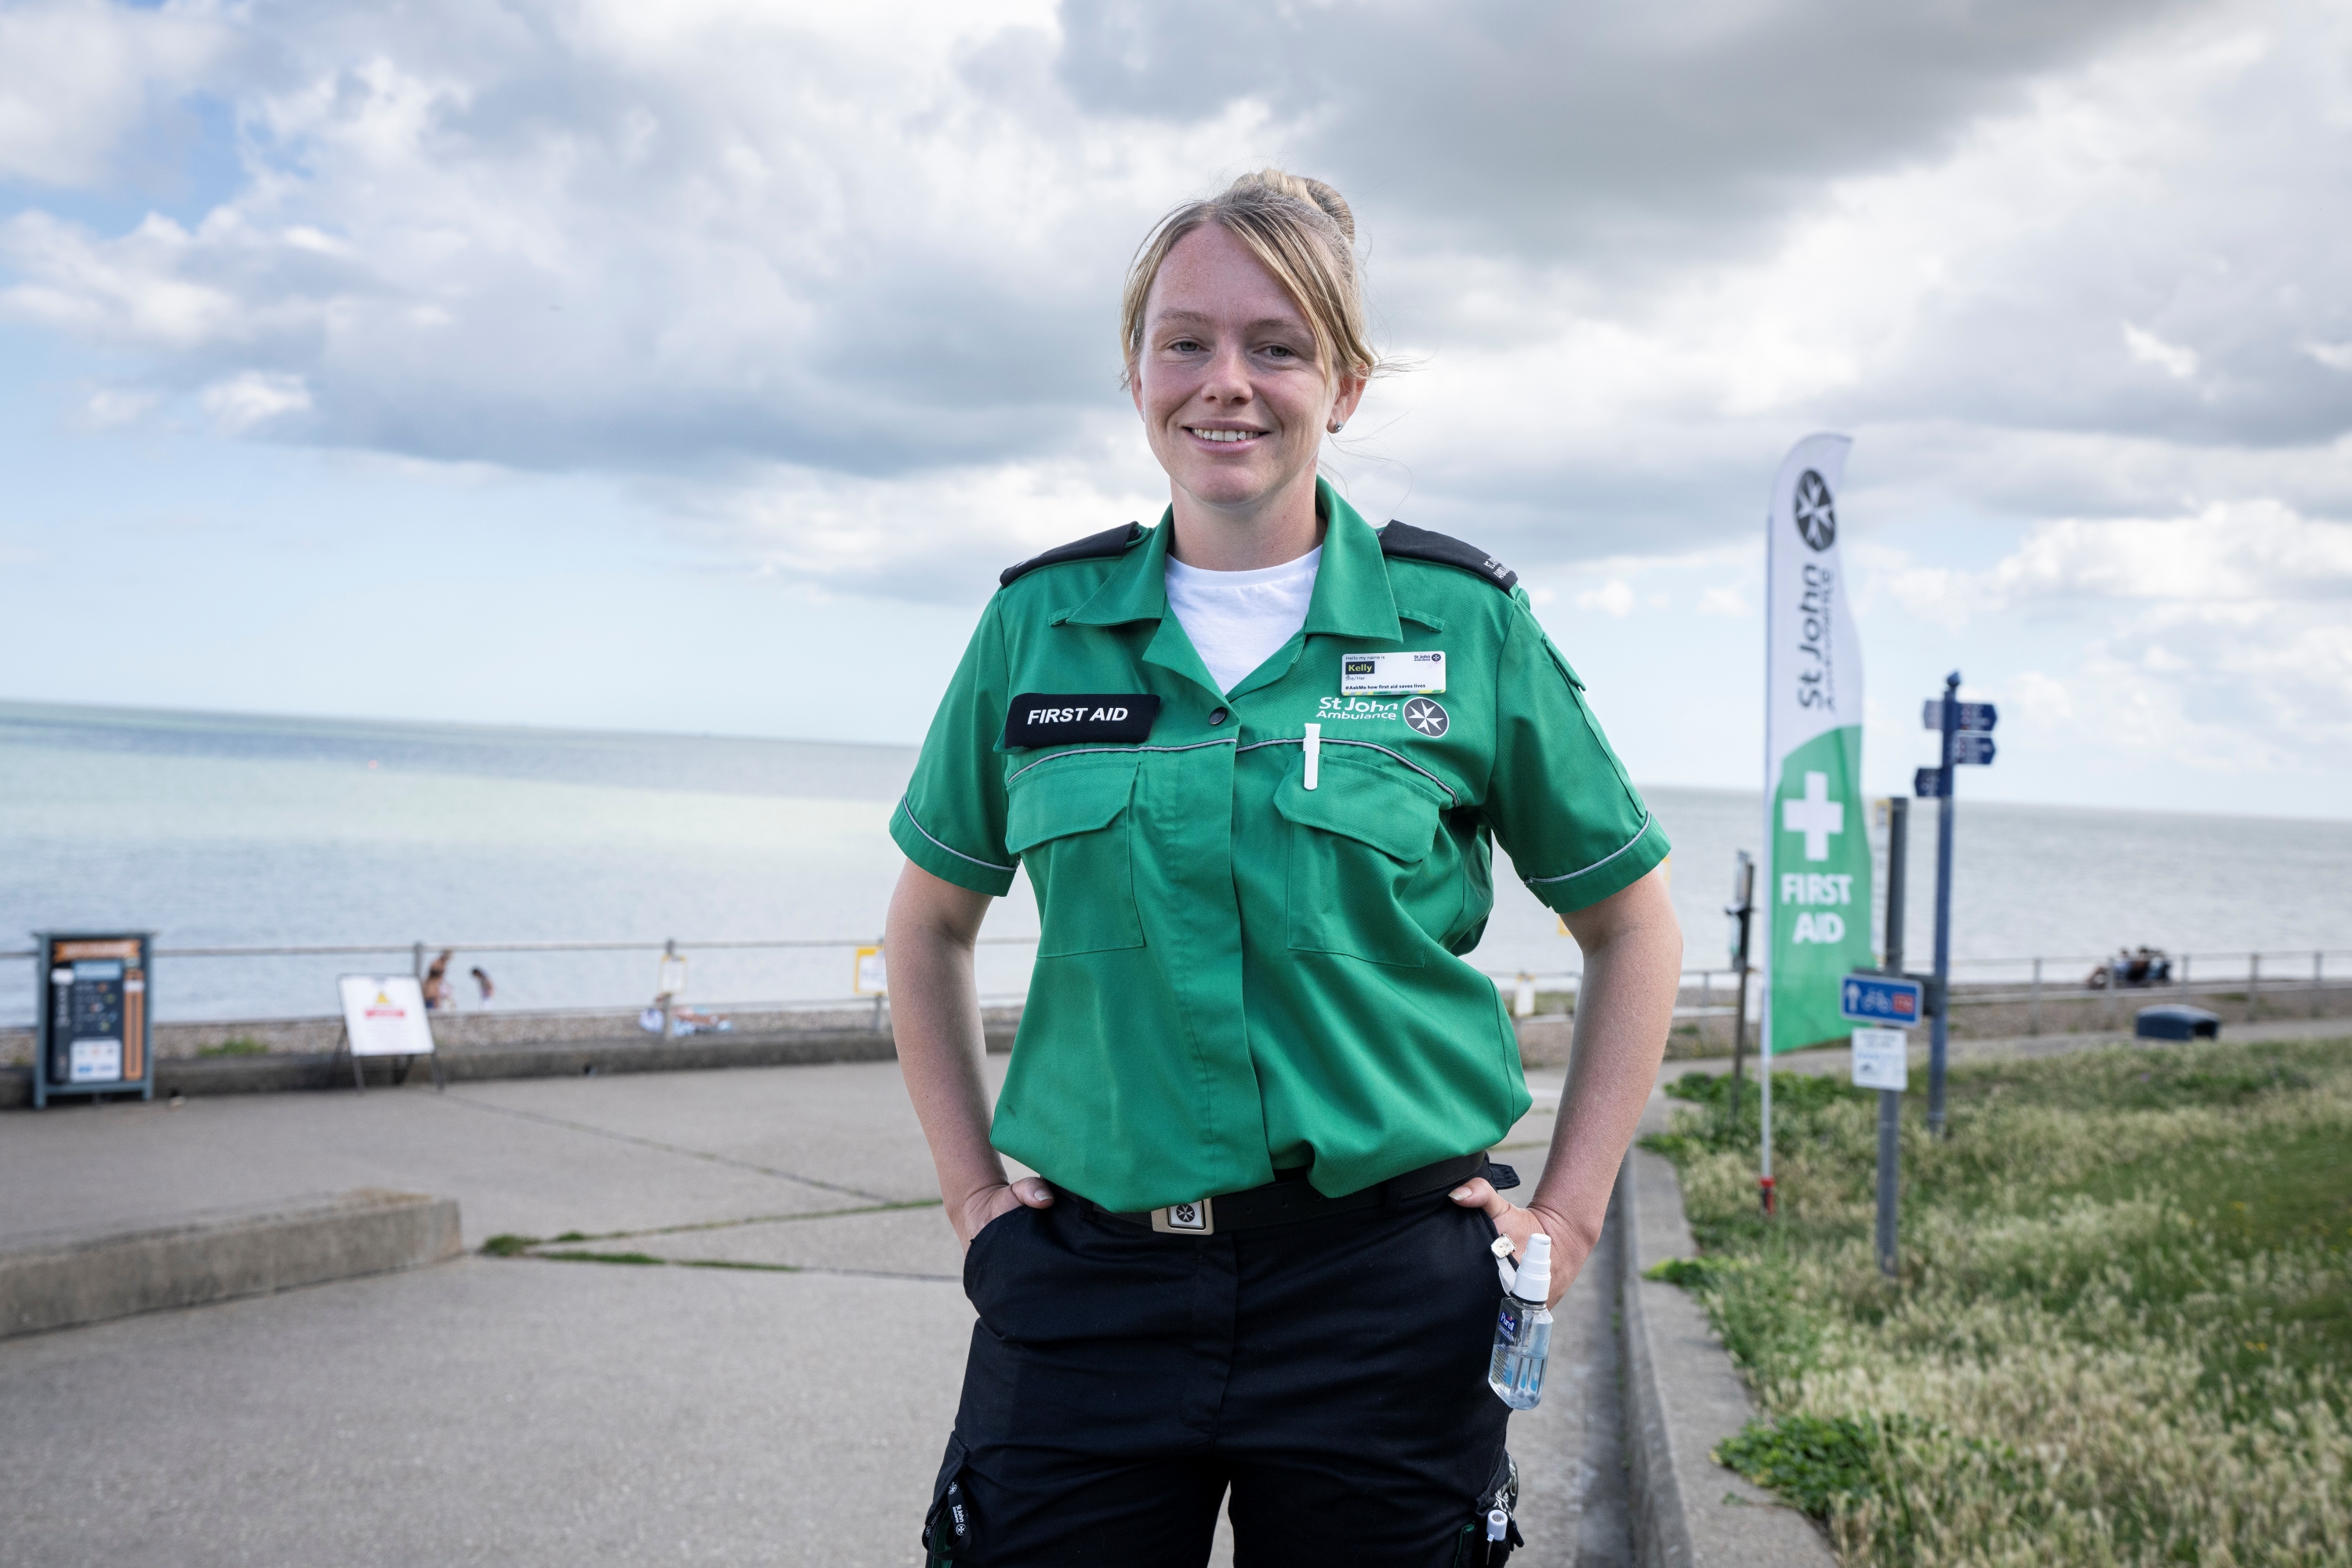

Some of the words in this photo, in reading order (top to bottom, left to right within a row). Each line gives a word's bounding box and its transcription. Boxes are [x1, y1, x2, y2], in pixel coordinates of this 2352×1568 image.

[1798, 563, 1821, 661] John
[1348, 664, 1373, 673] Kelly
[1798, 669, 1822, 711] St
[1319, 697, 1342, 710] St
[1345, 697, 1398, 712] John
[1027, 707, 1089, 725] FIRST
[1089, 707, 1128, 721] AID
[1316, 710, 1397, 720] Ambulance
[1781, 873, 1853, 905] FIRST
[1792, 912, 1846, 944] AID
[1500, 1312, 1515, 1332] Purell
